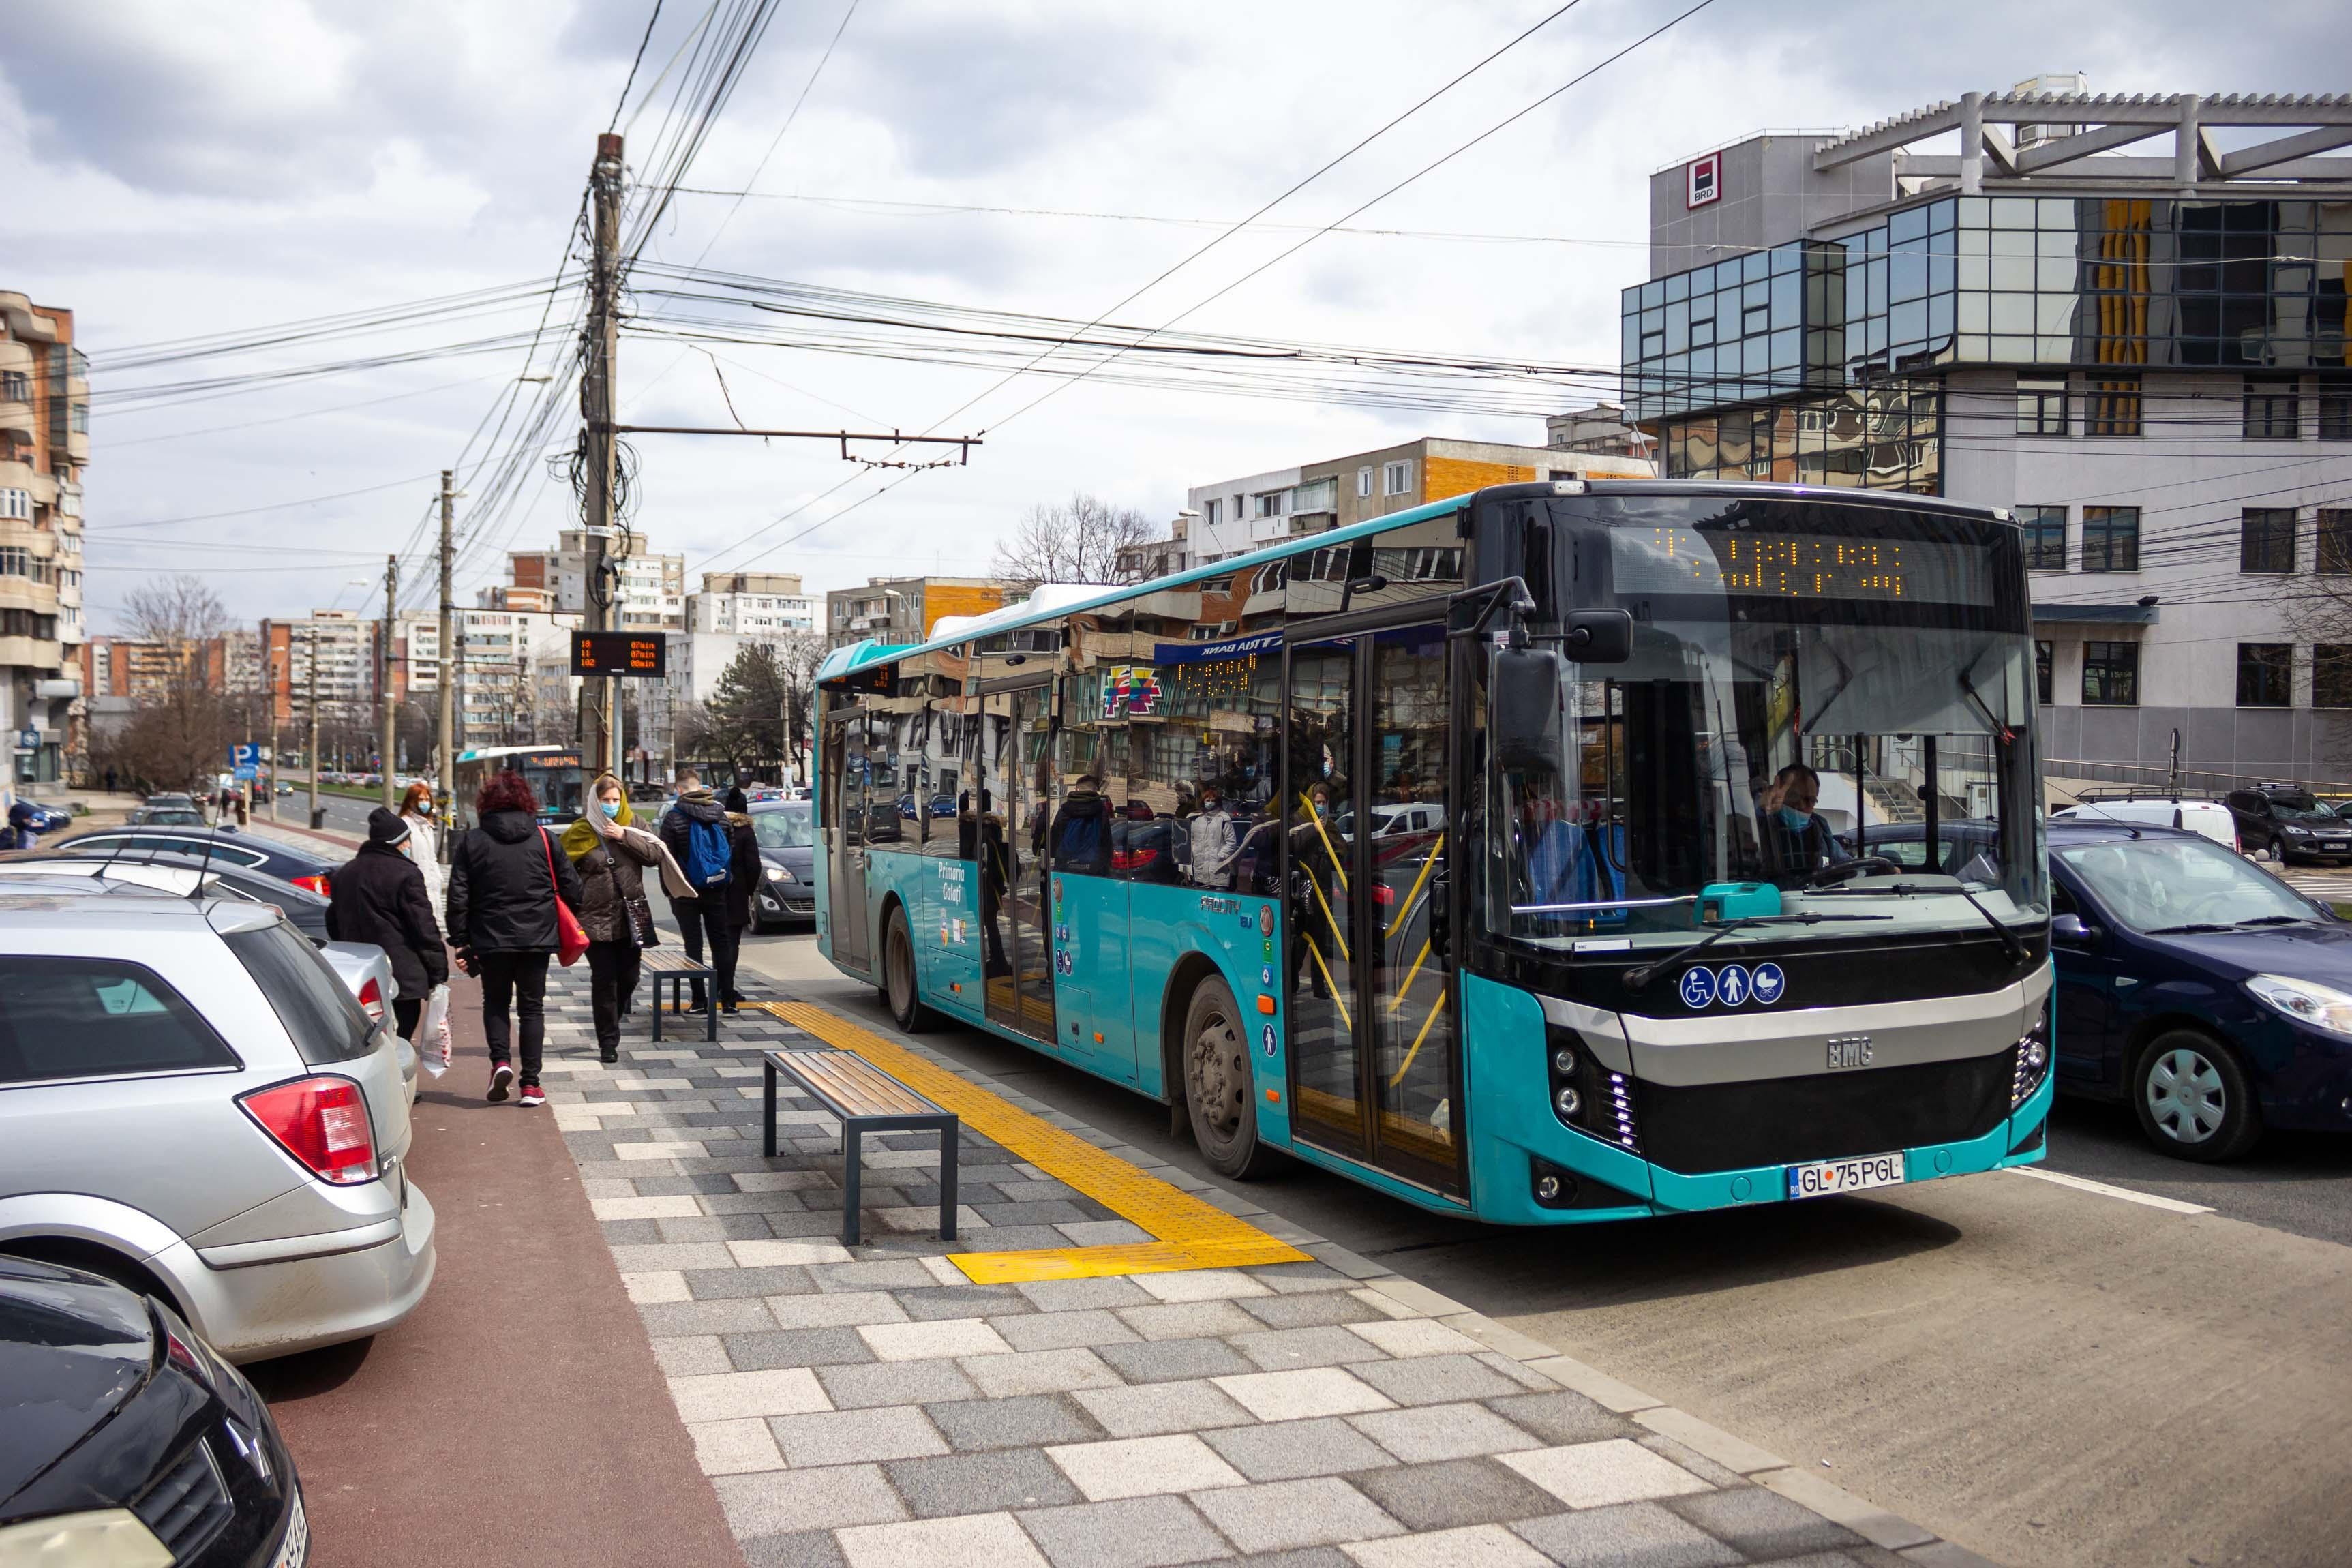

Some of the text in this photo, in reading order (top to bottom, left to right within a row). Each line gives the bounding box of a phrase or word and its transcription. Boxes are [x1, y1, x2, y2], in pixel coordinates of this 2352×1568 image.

[1695, 188, 1713, 202] BRD
[582, 649, 591, 658] 11
[582, 659, 595, 667] 102
[235, 744, 252, 766] P
[1827, 1036, 1873, 1068] BMC
[1790, 1186, 1799, 1194] RO
